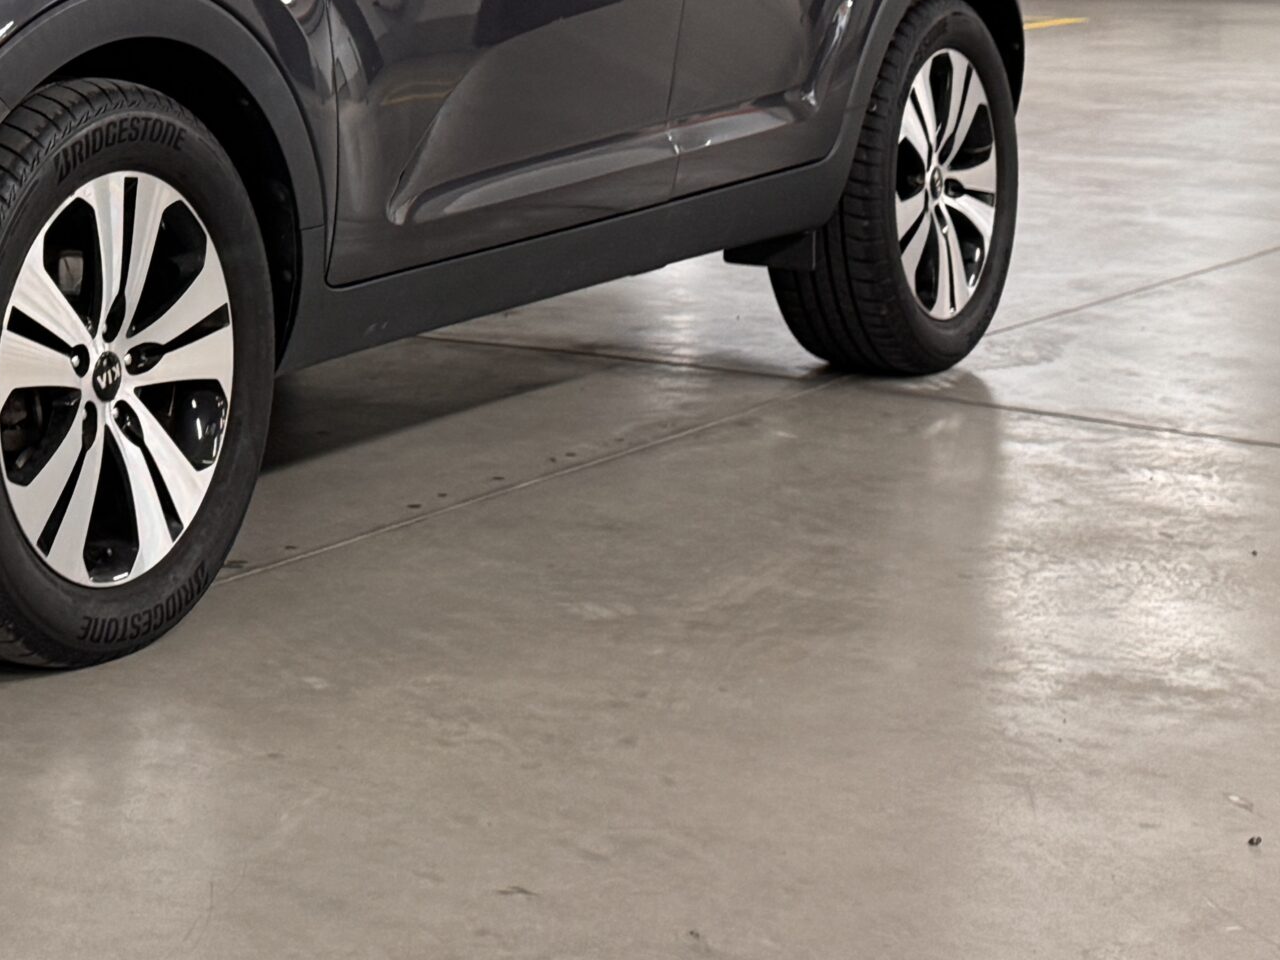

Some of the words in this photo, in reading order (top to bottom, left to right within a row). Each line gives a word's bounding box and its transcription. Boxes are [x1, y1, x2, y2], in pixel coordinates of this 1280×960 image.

[53, 116, 187, 186] BRIDGESTONE
[96, 362, 120, 390] KIA
[77, 559, 210, 643] BRIDGESTONE
